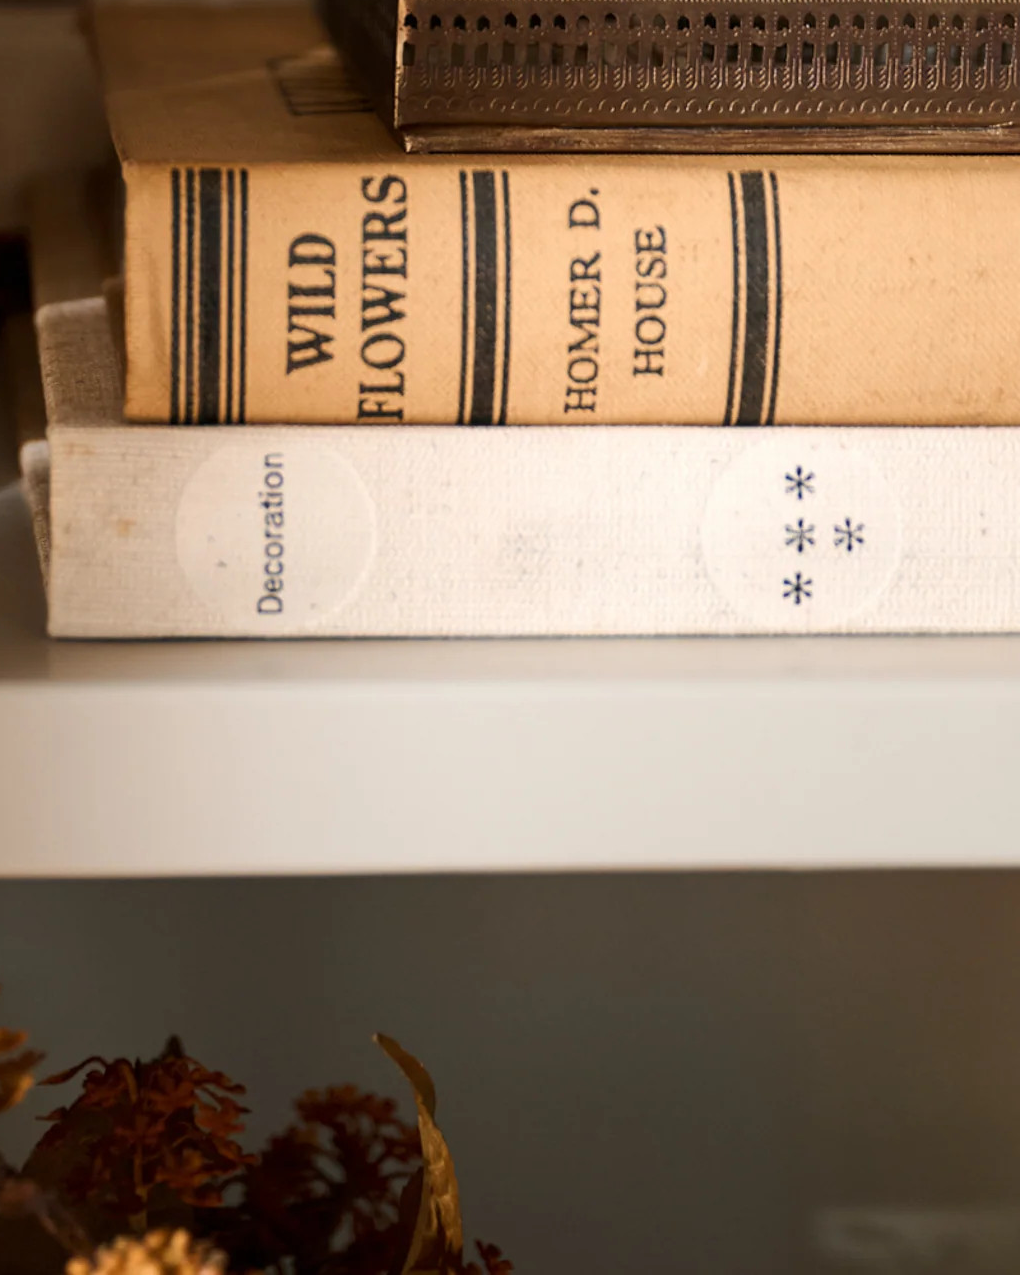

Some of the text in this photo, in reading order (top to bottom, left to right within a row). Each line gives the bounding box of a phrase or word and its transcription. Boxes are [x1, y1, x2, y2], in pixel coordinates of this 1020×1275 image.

[286, 233, 336, 375] WILD
[355, 174, 408, 422] FLOWERS
[563, 188, 601, 414] HOMER D.
[632, 225, 667, 377] HOUSE
[256, 453, 284, 615] Decoration
